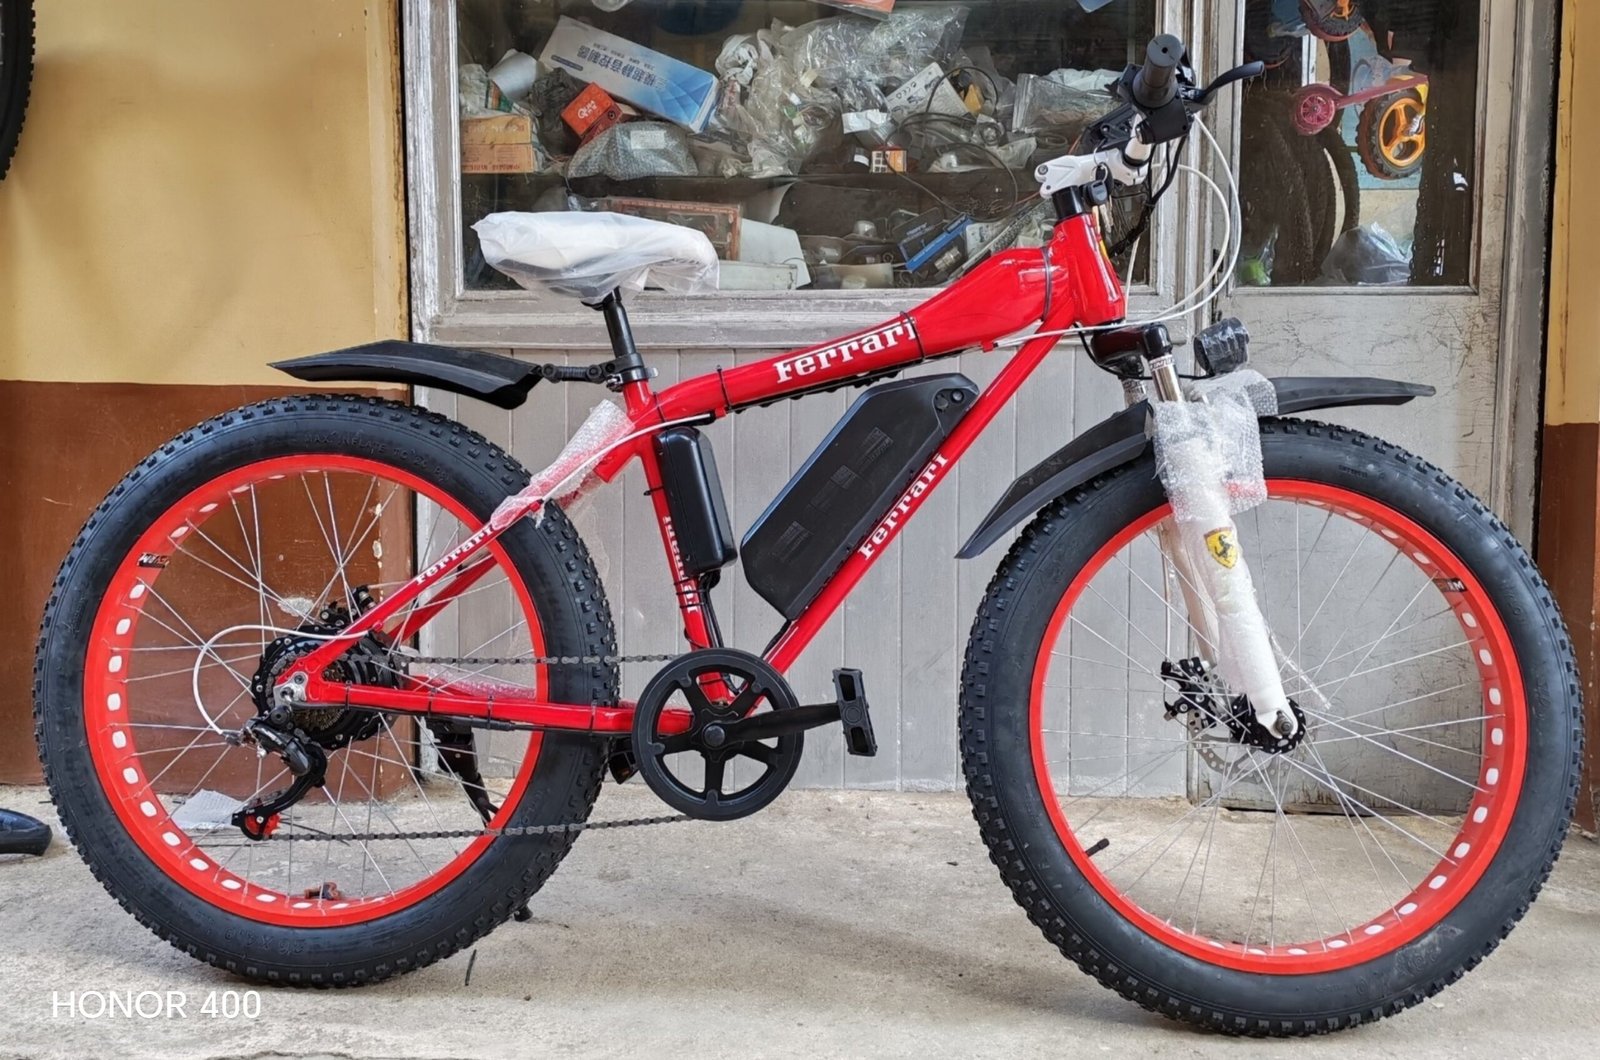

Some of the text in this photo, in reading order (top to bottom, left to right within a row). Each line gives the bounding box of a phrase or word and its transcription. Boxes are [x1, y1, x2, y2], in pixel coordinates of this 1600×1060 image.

[773, 318, 917, 384] Ferrari
[857, 453, 948, 560] Ferrari
[415, 523, 495, 586] Ferrari
